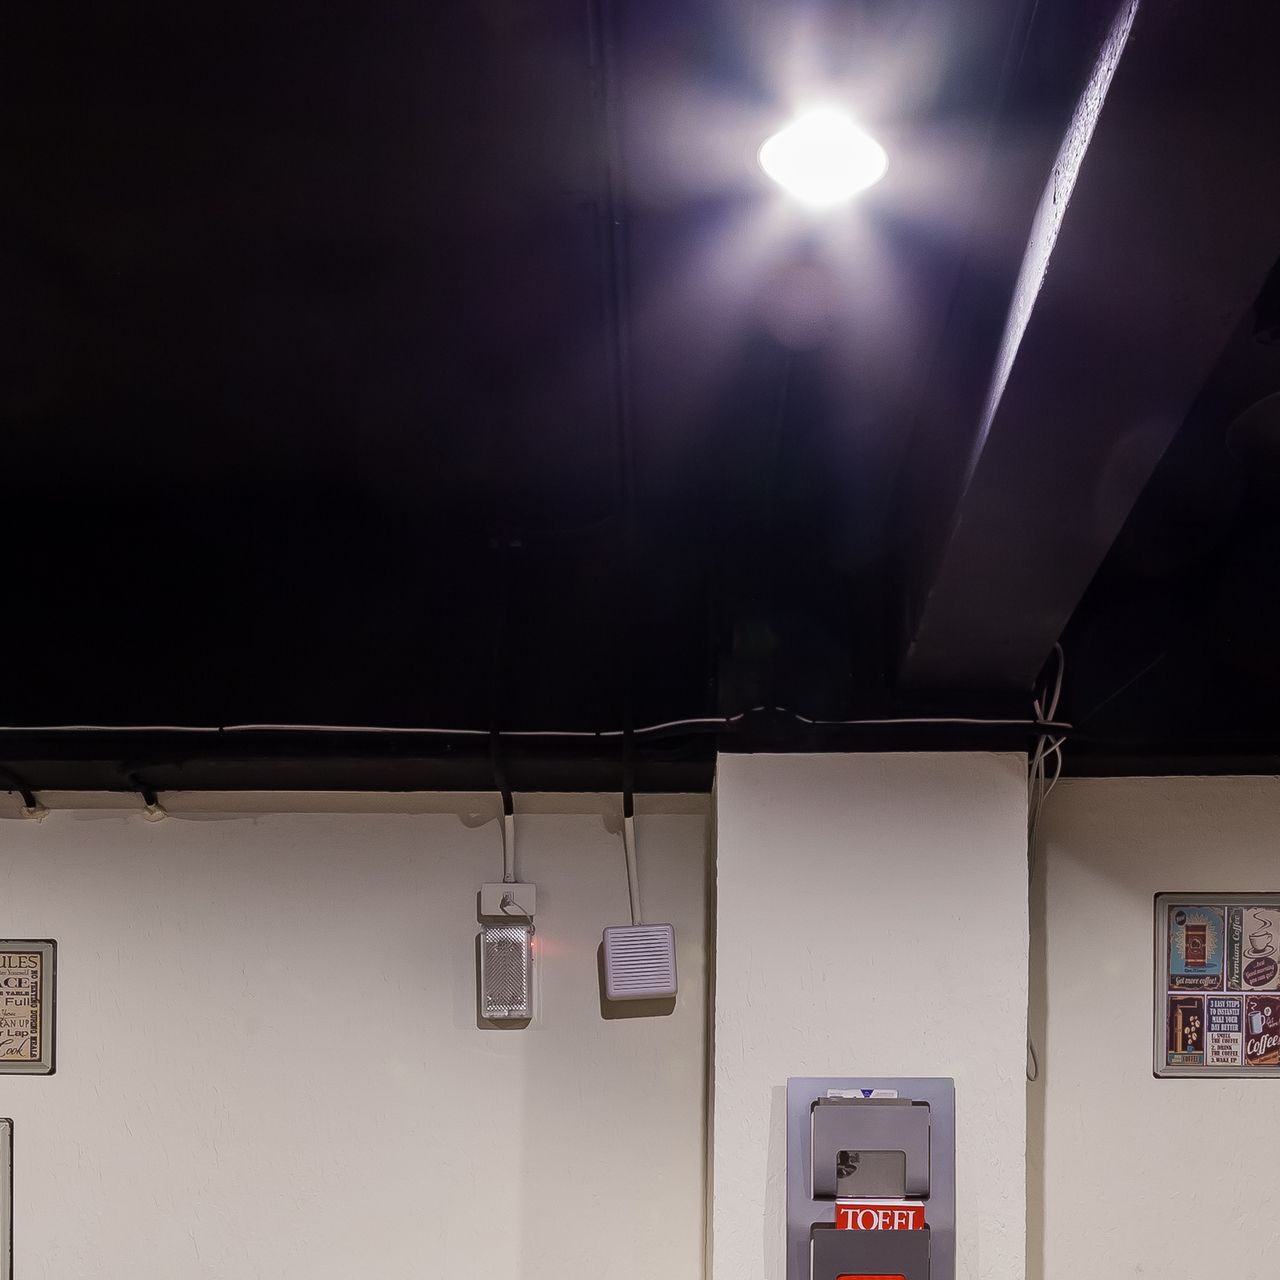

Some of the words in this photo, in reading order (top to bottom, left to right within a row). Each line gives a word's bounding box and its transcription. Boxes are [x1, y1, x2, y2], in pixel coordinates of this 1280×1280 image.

[1232, 943, 1241, 983] Premium
[31, 970, 38, 980] NO
[1199, 976, 1218, 987] coffee!
[5, 997, 30, 1006] Full
[19, 1018, 30, 1028] UP
[7, 1029, 30, 1037] Lap
[30, 1036, 39, 1058] MEALS
